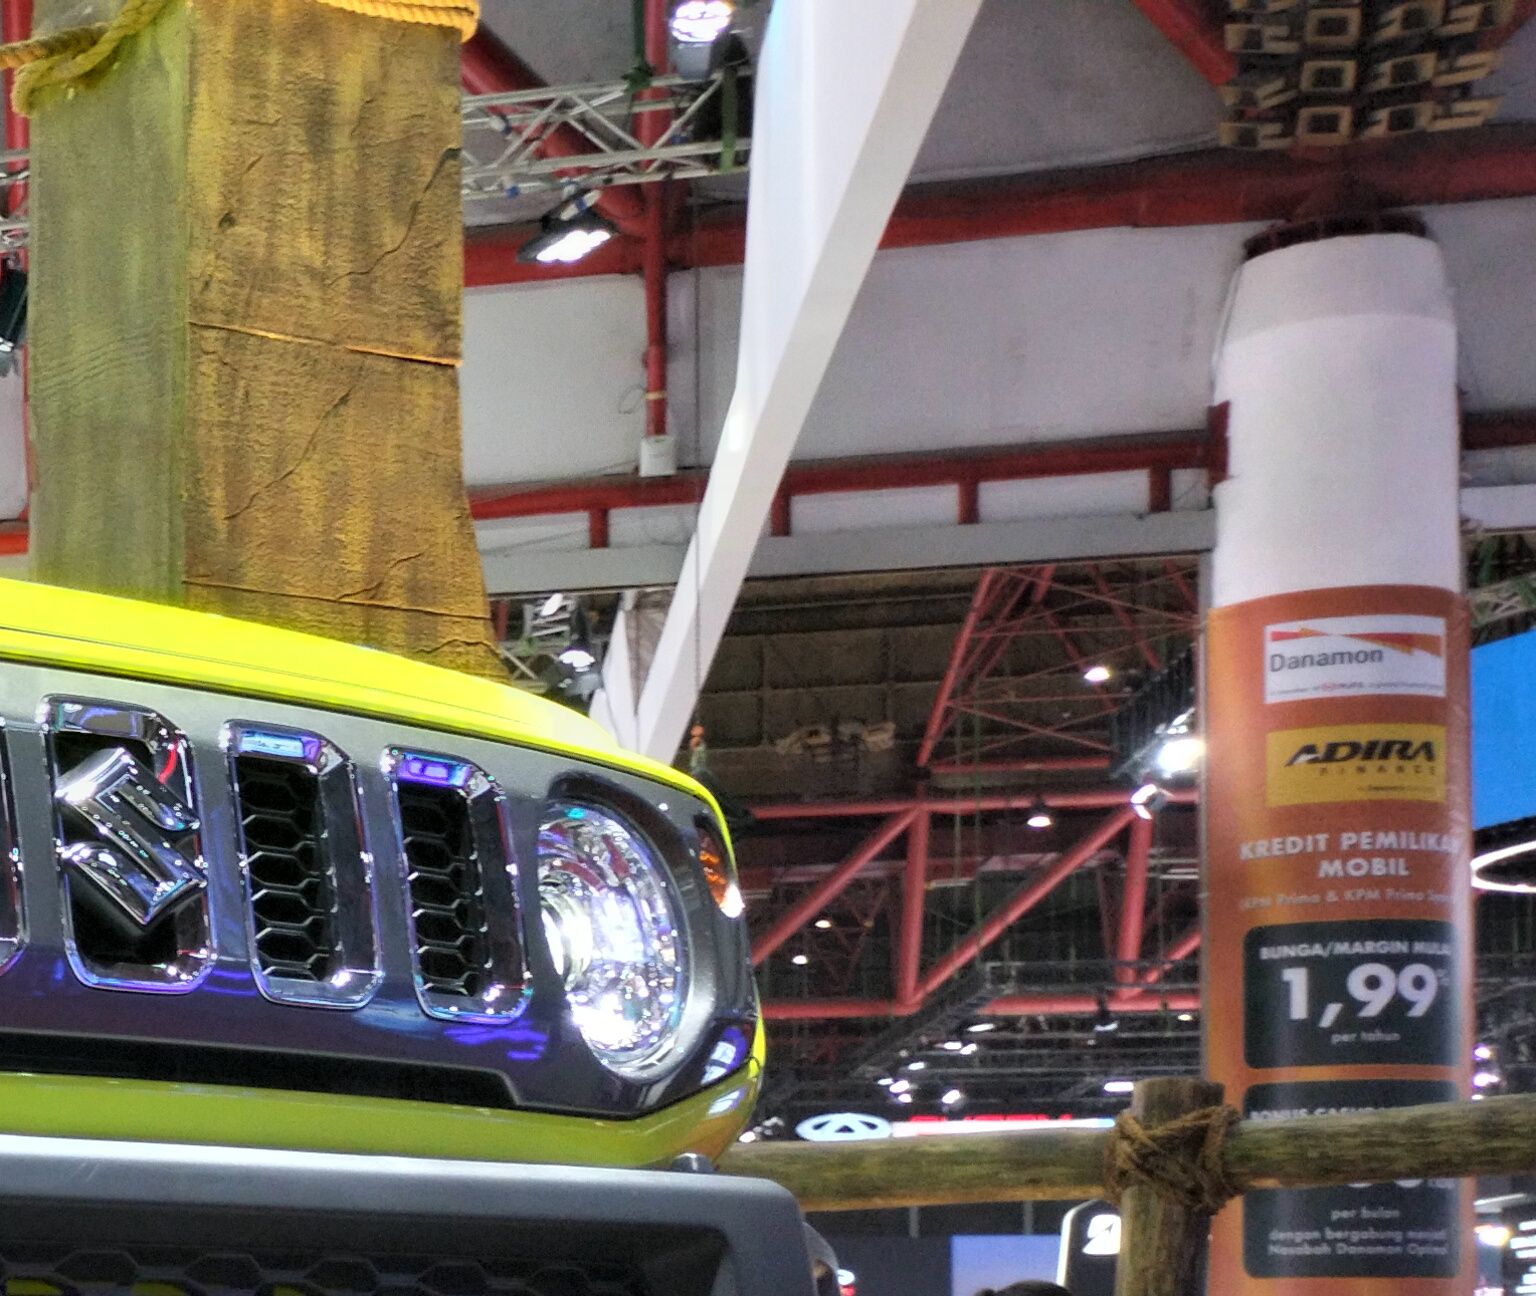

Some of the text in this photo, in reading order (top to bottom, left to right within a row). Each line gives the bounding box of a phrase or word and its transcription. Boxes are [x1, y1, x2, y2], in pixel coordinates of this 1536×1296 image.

[1270, 649, 1384, 672] Danamon
[1284, 739, 1436, 767] ADIRA
[1240, 834, 1329, 860] KREDIT
[1318, 858, 1410, 878] MOBIL
[1259, 940, 1408, 960] BUNGA/MARGIN
[1330, 1032, 1357, 1045] per
